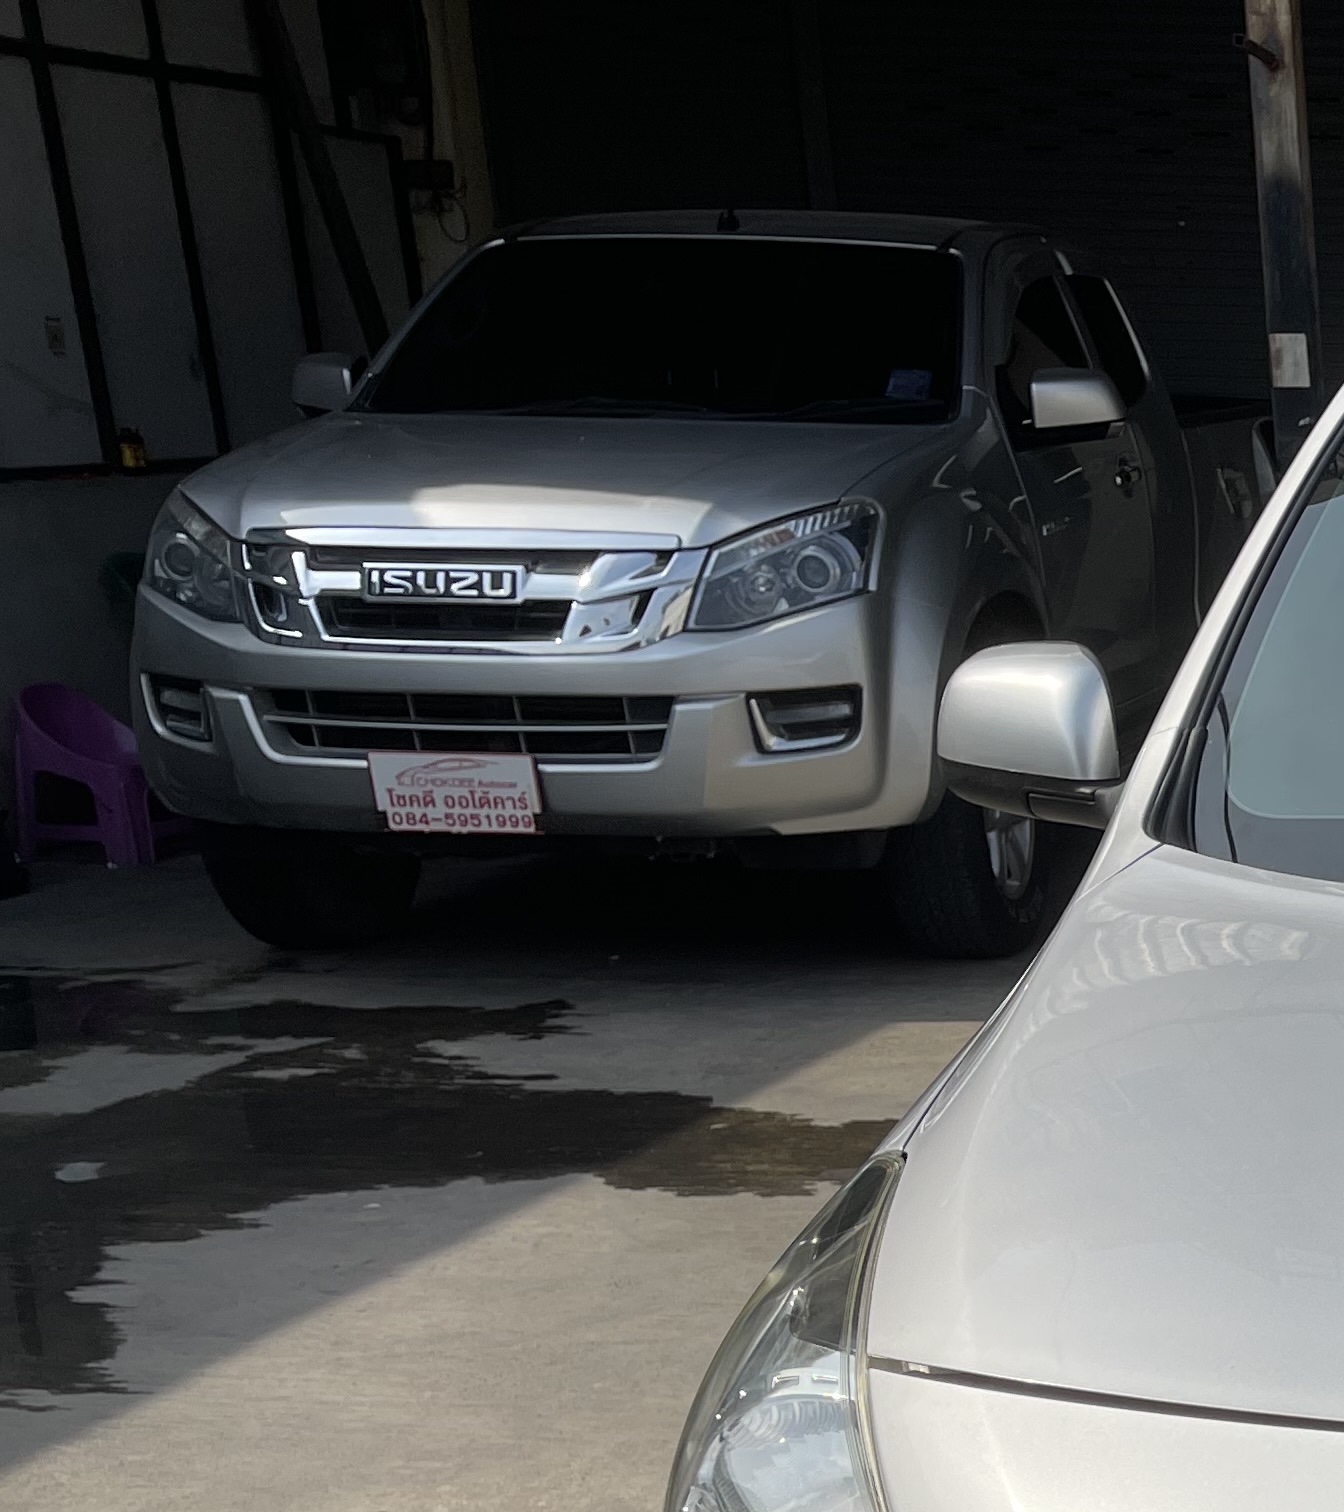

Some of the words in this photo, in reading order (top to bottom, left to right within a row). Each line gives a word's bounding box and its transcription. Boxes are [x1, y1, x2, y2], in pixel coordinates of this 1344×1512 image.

[370, 569, 513, 598] ISUZU
[386, 788, 436, 809] โชคดี
[392, 812, 533, 829] 084-5951999
